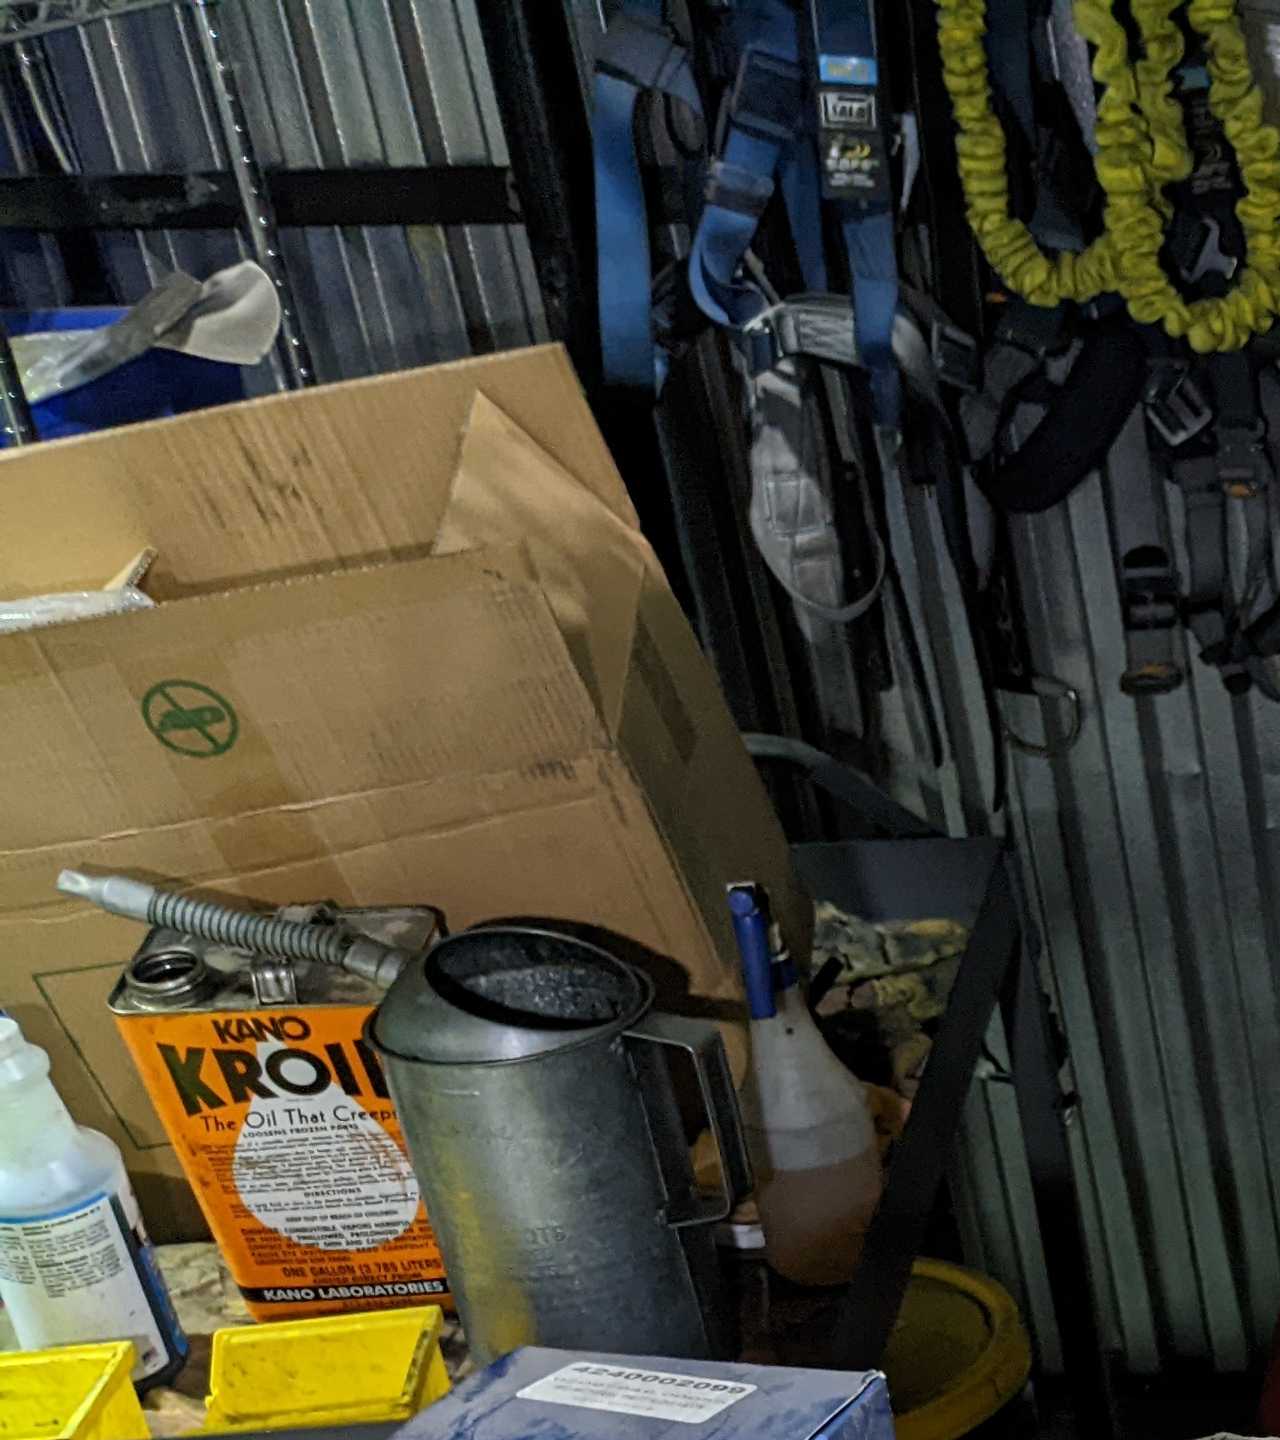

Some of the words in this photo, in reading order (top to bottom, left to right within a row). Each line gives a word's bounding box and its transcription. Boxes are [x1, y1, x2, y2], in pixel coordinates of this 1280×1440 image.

[212, 1016, 311, 1043] KANO
[200, 1114, 237, 1133] The
[246, 1109, 278, 1128] Oil
[284, 1108, 326, 1126] That
[243, 1129, 287, 1139] LOOSENS
[290, 1126, 327, 1135] FROZEN
[330, 1123, 359, 1132] PARTS
[304, 1187, 362, 1197] DIRECTIONS
[282, 1267, 307, 1278] ONE
[310, 1265, 356, 1277] GALLON
[263, 1289, 315, 1301] KANO
[319, 1281, 444, 1299] LABORATORIES
